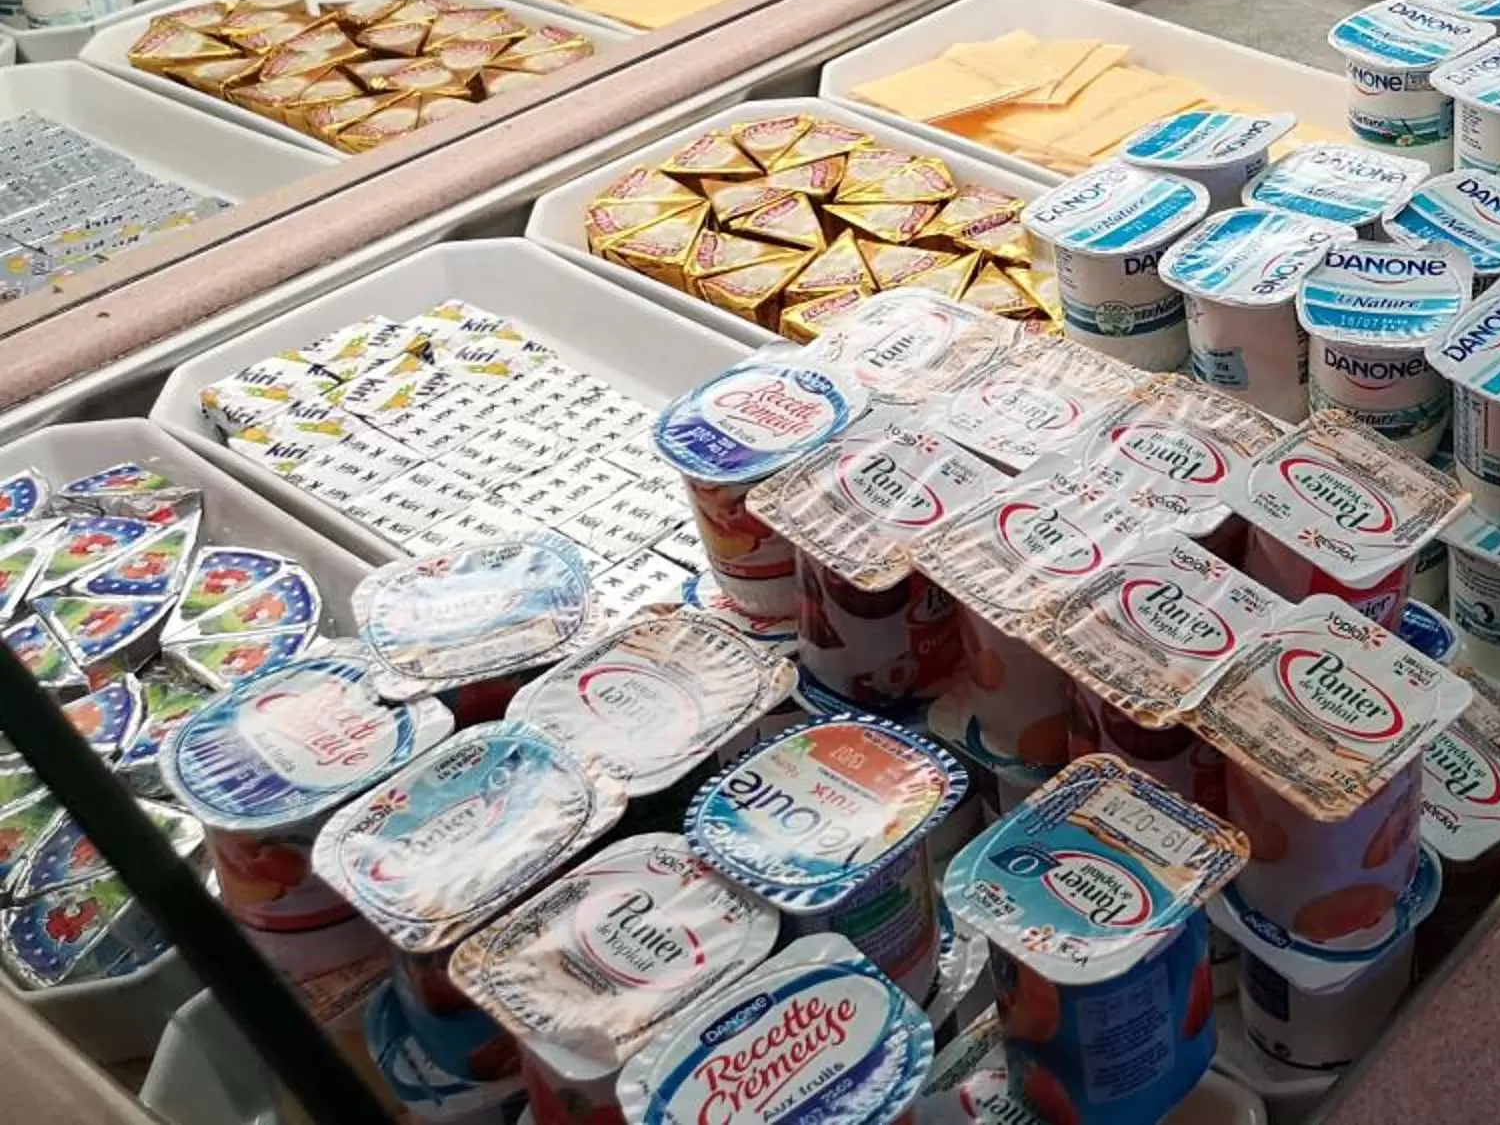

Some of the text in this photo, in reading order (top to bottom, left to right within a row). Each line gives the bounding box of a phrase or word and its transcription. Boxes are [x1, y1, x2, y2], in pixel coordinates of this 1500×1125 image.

[1124, 247, 1174, 276] DAN
[1324, 251, 1447, 277] DANONE
[1294, 473, 1371, 530] Panier
[1145, 581, 1223, 641] Panier
[1304, 648, 1390, 719] Panier
[1308, 685, 1361, 725] Yoplait
[606, 888, 687, 964] Panier
[1052, 868, 1129, 928] Panier
[694, 995, 827, 1092] Recette
[705, 994, 768, 1043] DANONE
